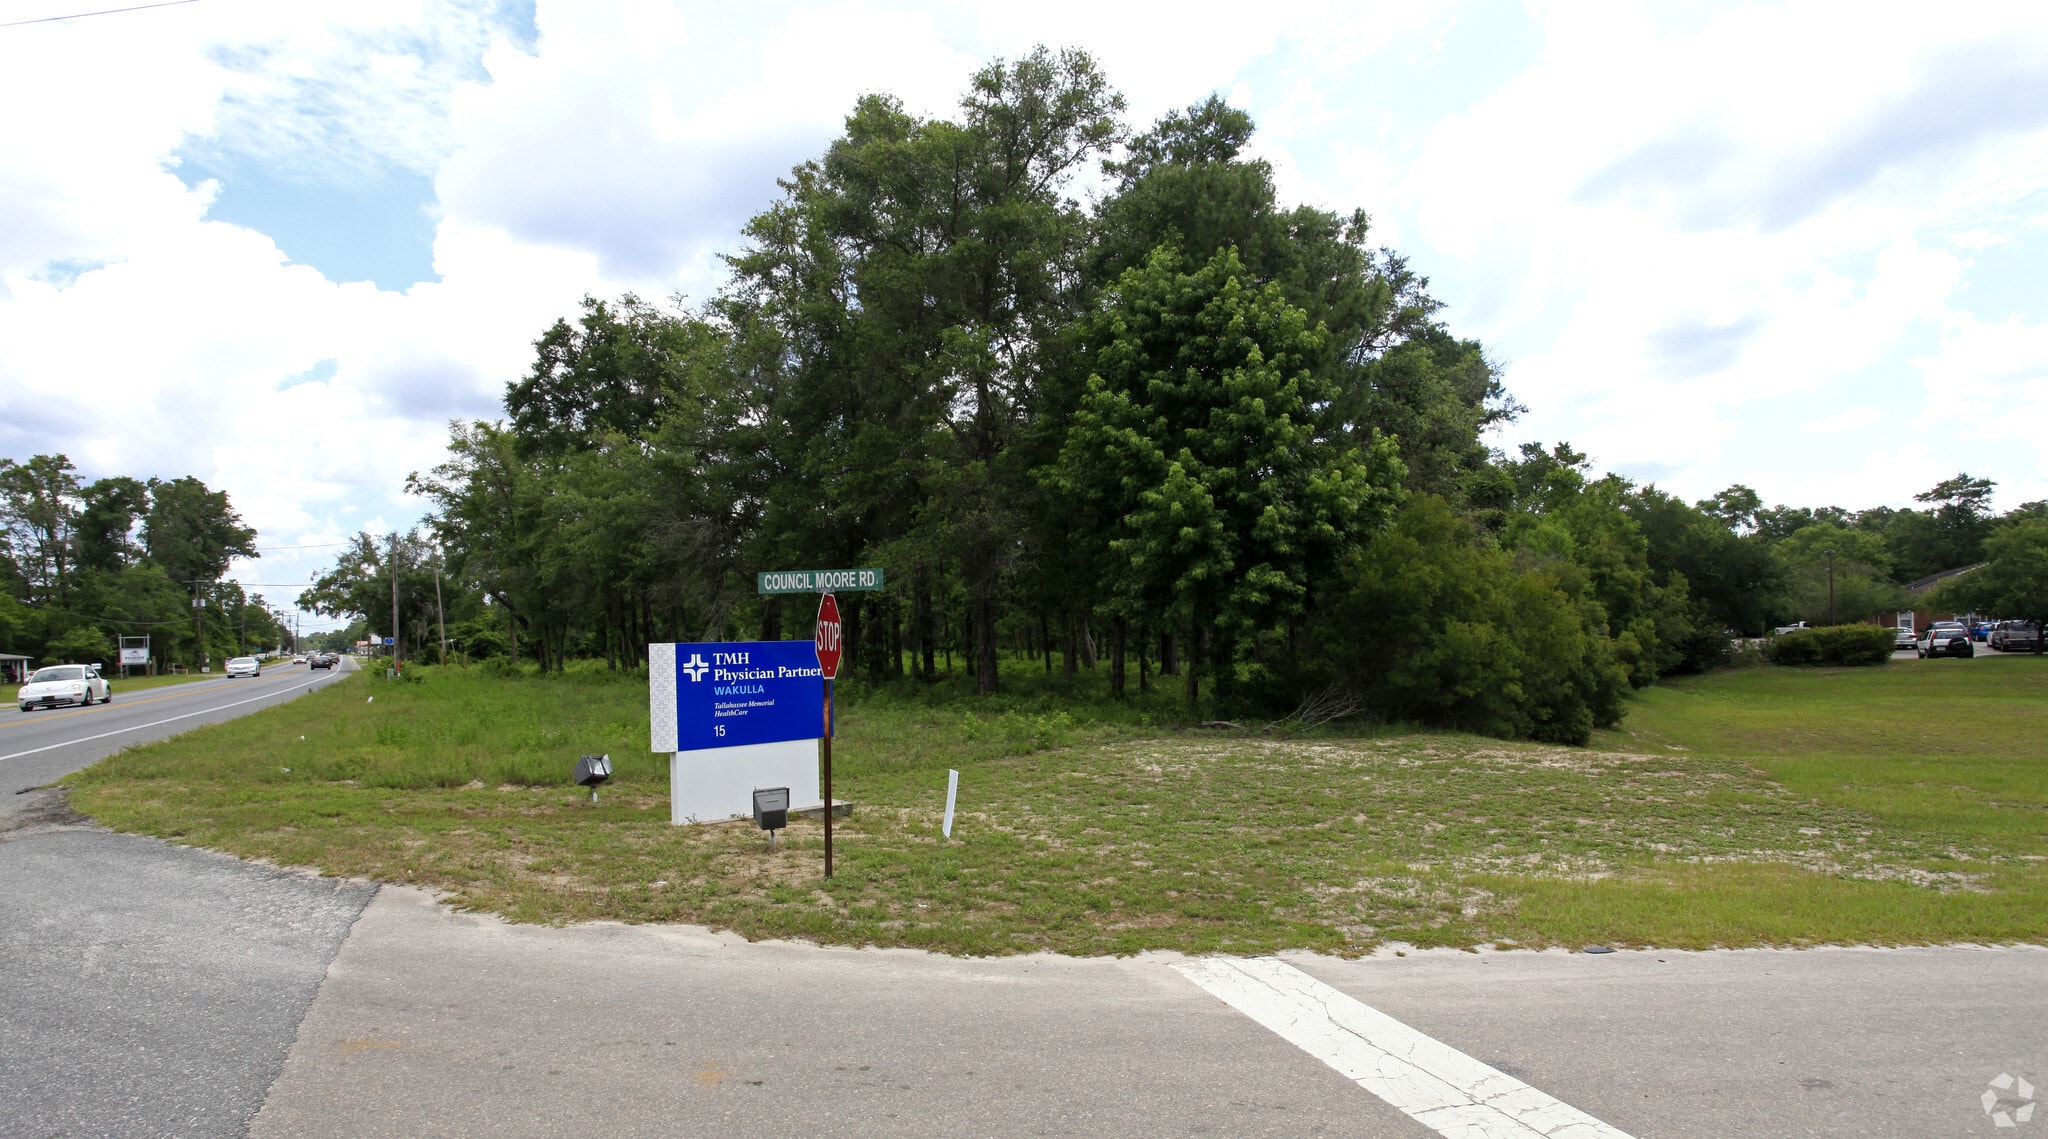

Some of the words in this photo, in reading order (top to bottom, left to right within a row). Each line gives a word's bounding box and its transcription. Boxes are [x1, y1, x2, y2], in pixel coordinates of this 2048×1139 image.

[764, 573, 813, 590] COUNCIL
[815, 571, 856, 588] MOORE
[859, 571, 875, 587] RD
[817, 620, 840, 652] STOP
[713, 652, 750, 665] TMH
[714, 668, 775, 685] Physician
[778, 666, 822, 678] Partner
[714, 684, 765, 696] WAKULLA
[714, 701, 748, 710] Tallahassee
[748, 699, 775, 708] Memorial
[714, 709, 749, 717] HealthCare
[714, 725, 726, 737] 15
